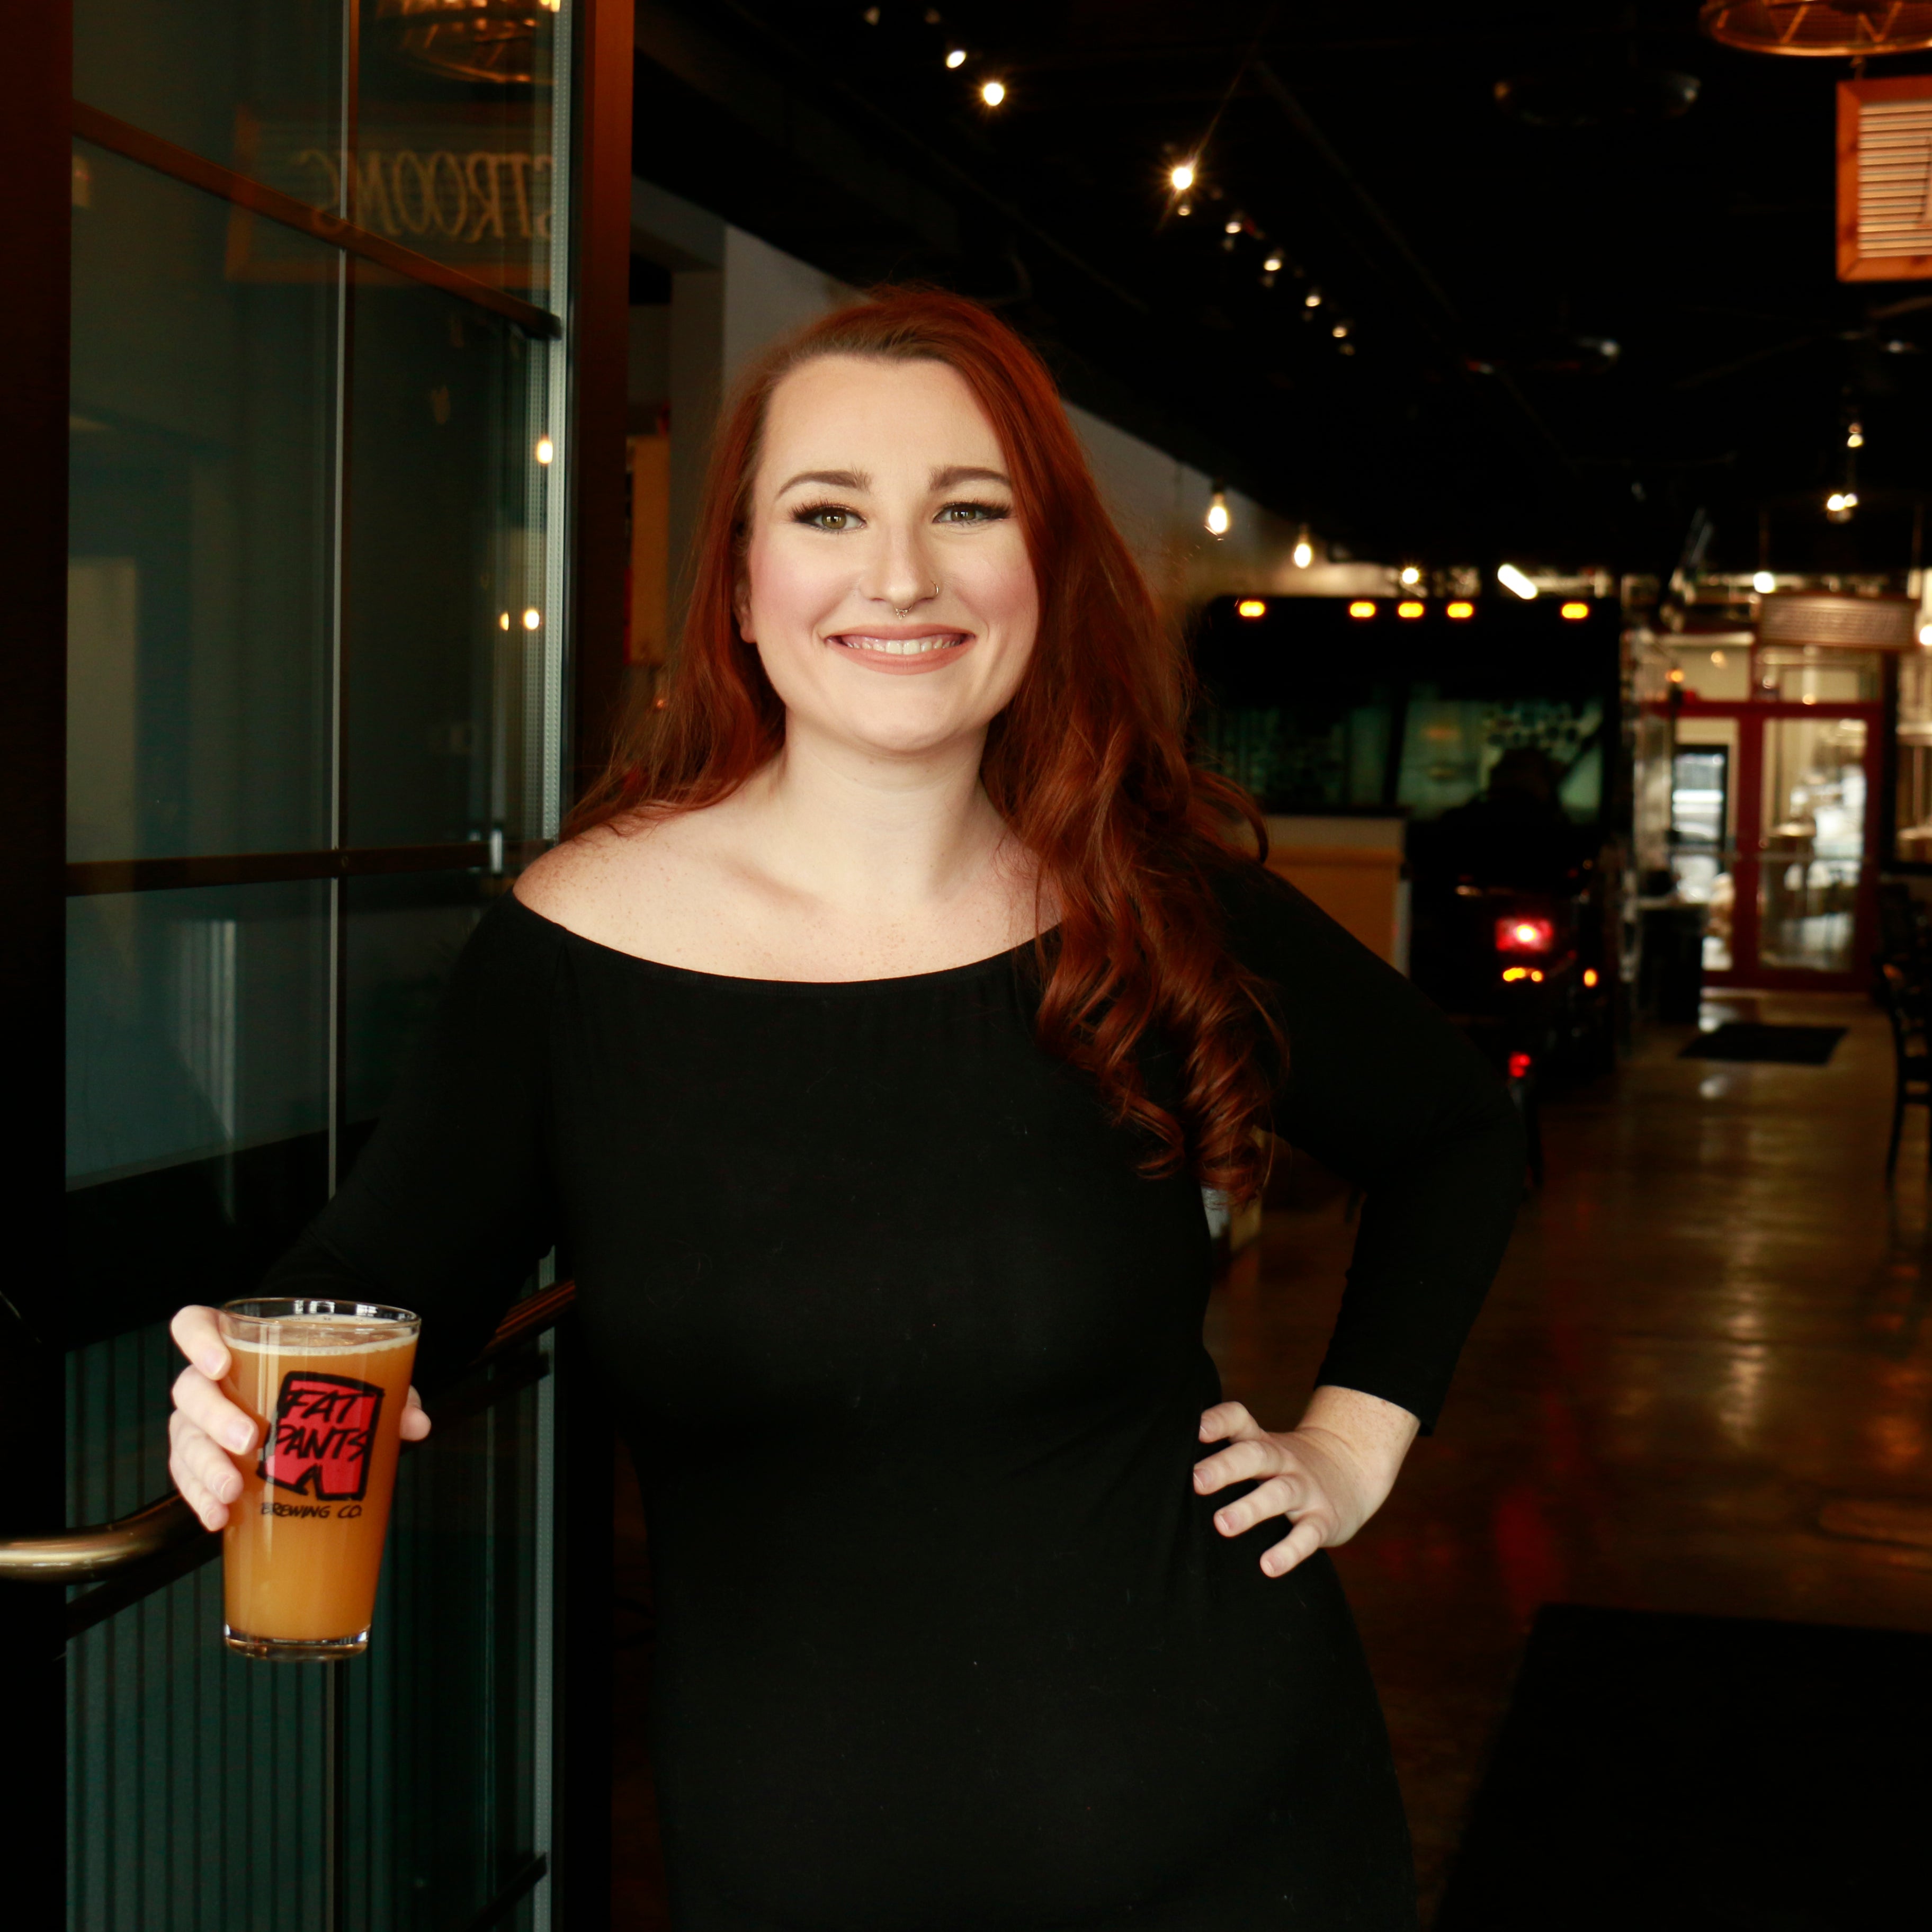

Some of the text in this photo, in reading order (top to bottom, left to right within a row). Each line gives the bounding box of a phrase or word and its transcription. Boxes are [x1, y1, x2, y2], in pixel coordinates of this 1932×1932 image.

[279, 1388, 375, 1423] FAT
[275, 1424, 369, 1462] PANTS
[261, 1502, 330, 1518] BREWING
